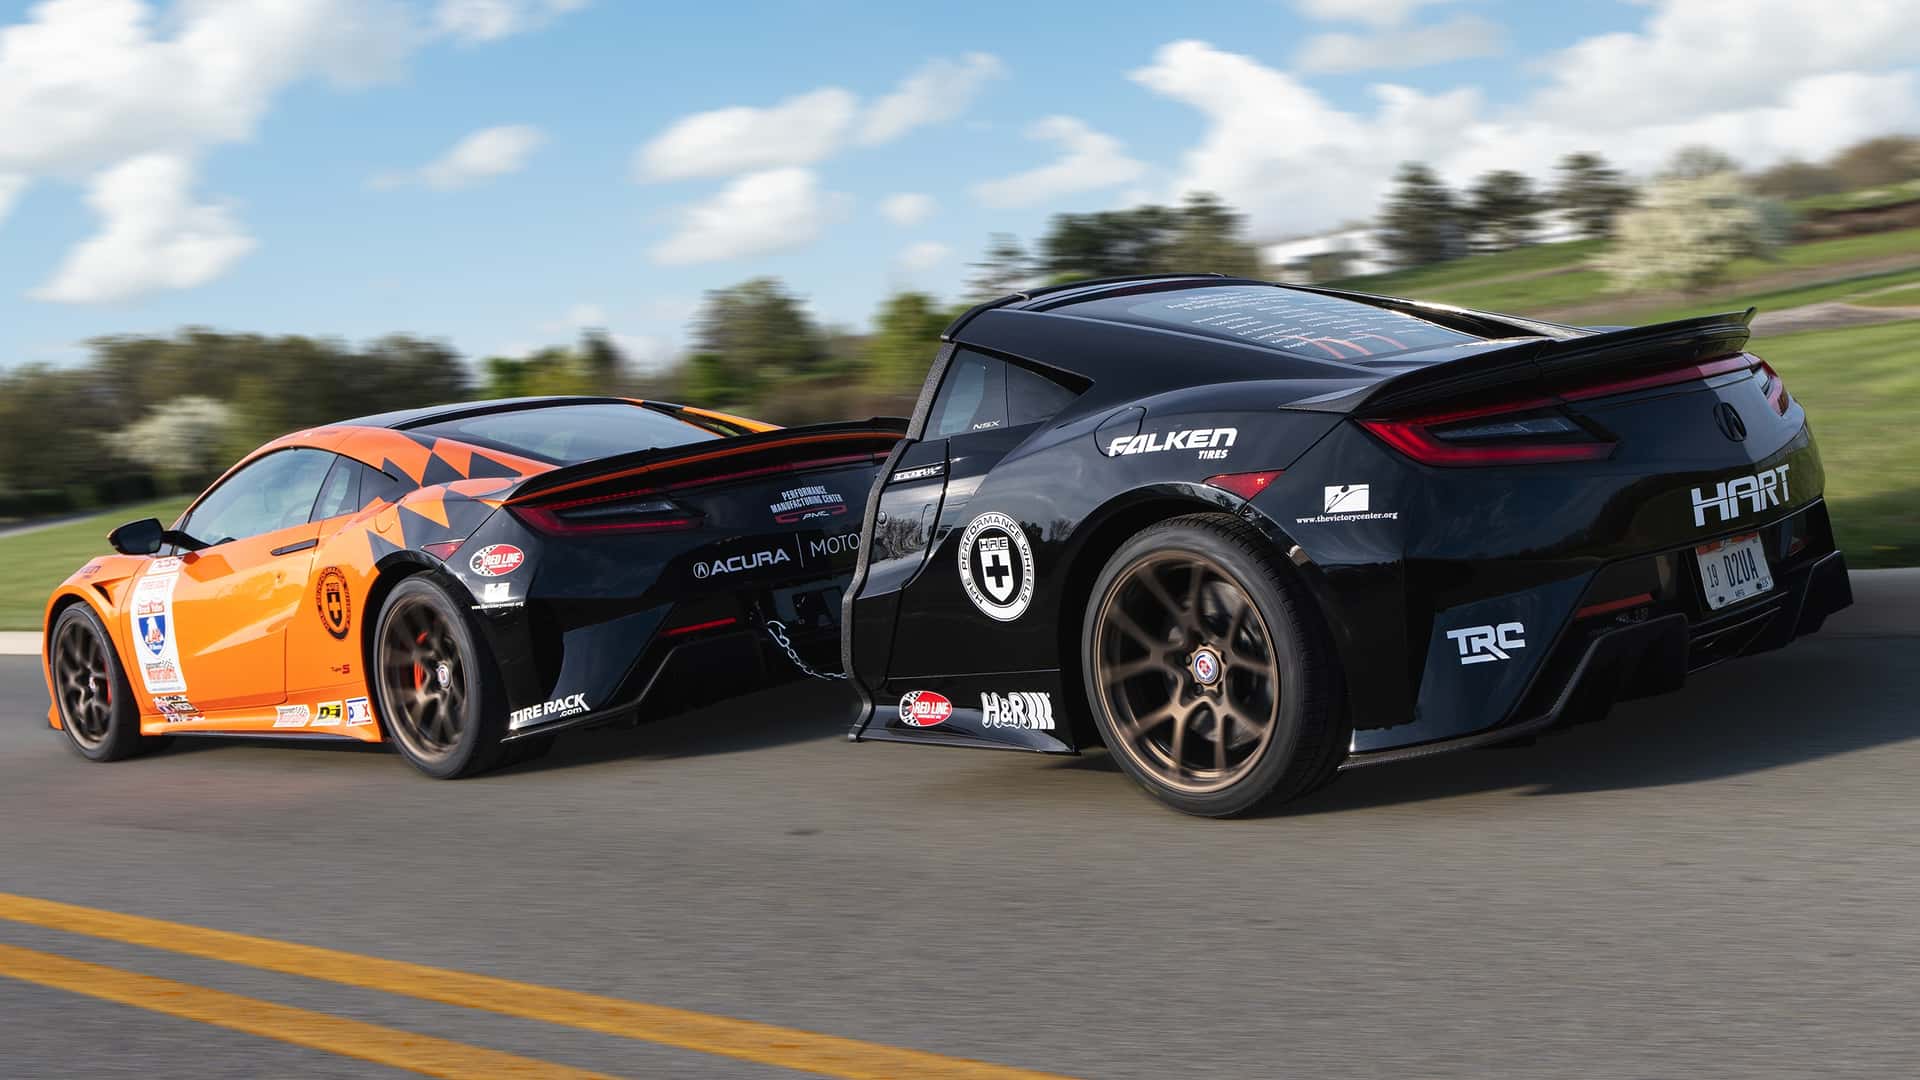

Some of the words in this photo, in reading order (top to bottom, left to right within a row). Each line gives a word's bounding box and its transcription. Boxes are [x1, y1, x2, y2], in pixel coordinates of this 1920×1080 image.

[973, 419, 1001, 430] NSX
[1106, 427, 1238, 457] FALKEN
[1198, 449, 1228, 460] TIRES
[770, 495, 822, 513] MANUFACTURING
[821, 493, 843, 504] CENTER
[781, 485, 827, 501] PERFORMANCE
[1690, 463, 1790, 528] HART
[1296, 511, 1398, 524] www.thevictorycenter.org
[486, 553, 502, 567] RED
[501, 552, 521, 564] LINE
[711, 548, 791, 576] ACURA
[961, 515, 1022, 571] PERFORMANCE
[1020, 543, 1033, 603] WHEELS
[1706, 563, 1720, 588] 19
[1723, 547, 1759, 588] D2UA
[1446, 622, 1526, 665] TRC
[510, 703, 542, 723] TIRE
[543, 692, 591, 716] RACK
[559, 706, 582, 717] .com
[914, 701, 932, 714] RED
[931, 701, 949, 715] LINE
[981, 692, 1031, 728] H&R
